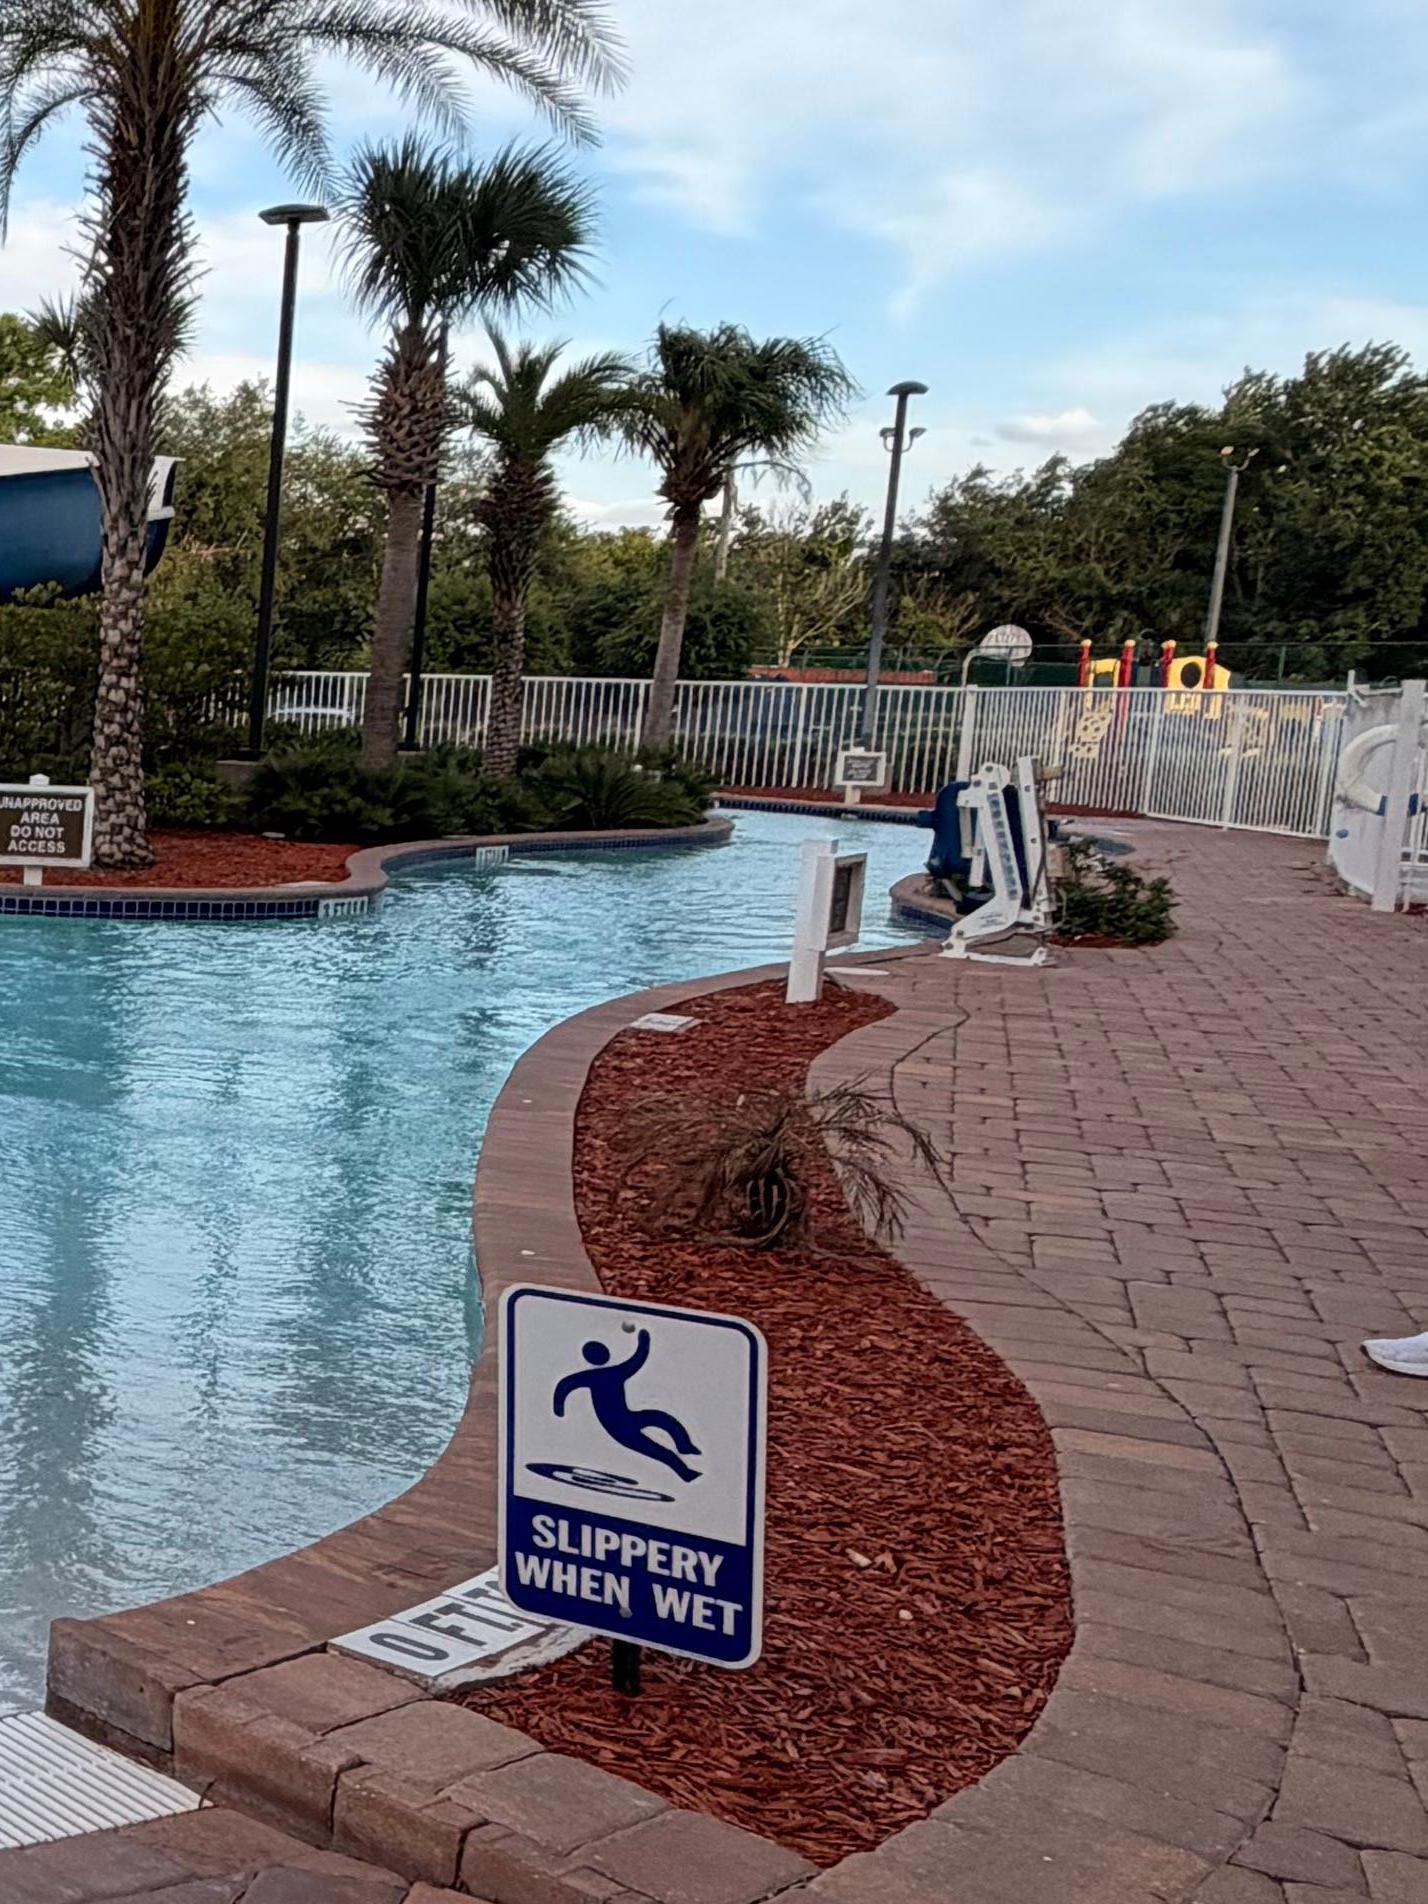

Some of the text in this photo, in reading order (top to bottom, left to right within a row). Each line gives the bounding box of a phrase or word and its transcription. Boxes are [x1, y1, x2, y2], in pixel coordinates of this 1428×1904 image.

[20, 811, 59, 824] AREA
[10, 824, 65, 838] DO NOT
[7, 839, 66, 853] ACCESS
[531, 1514, 725, 1587] SLIPPERY
[514, 1551, 744, 1636] WHEN WET
[368, 1632, 450, 1661] 0
